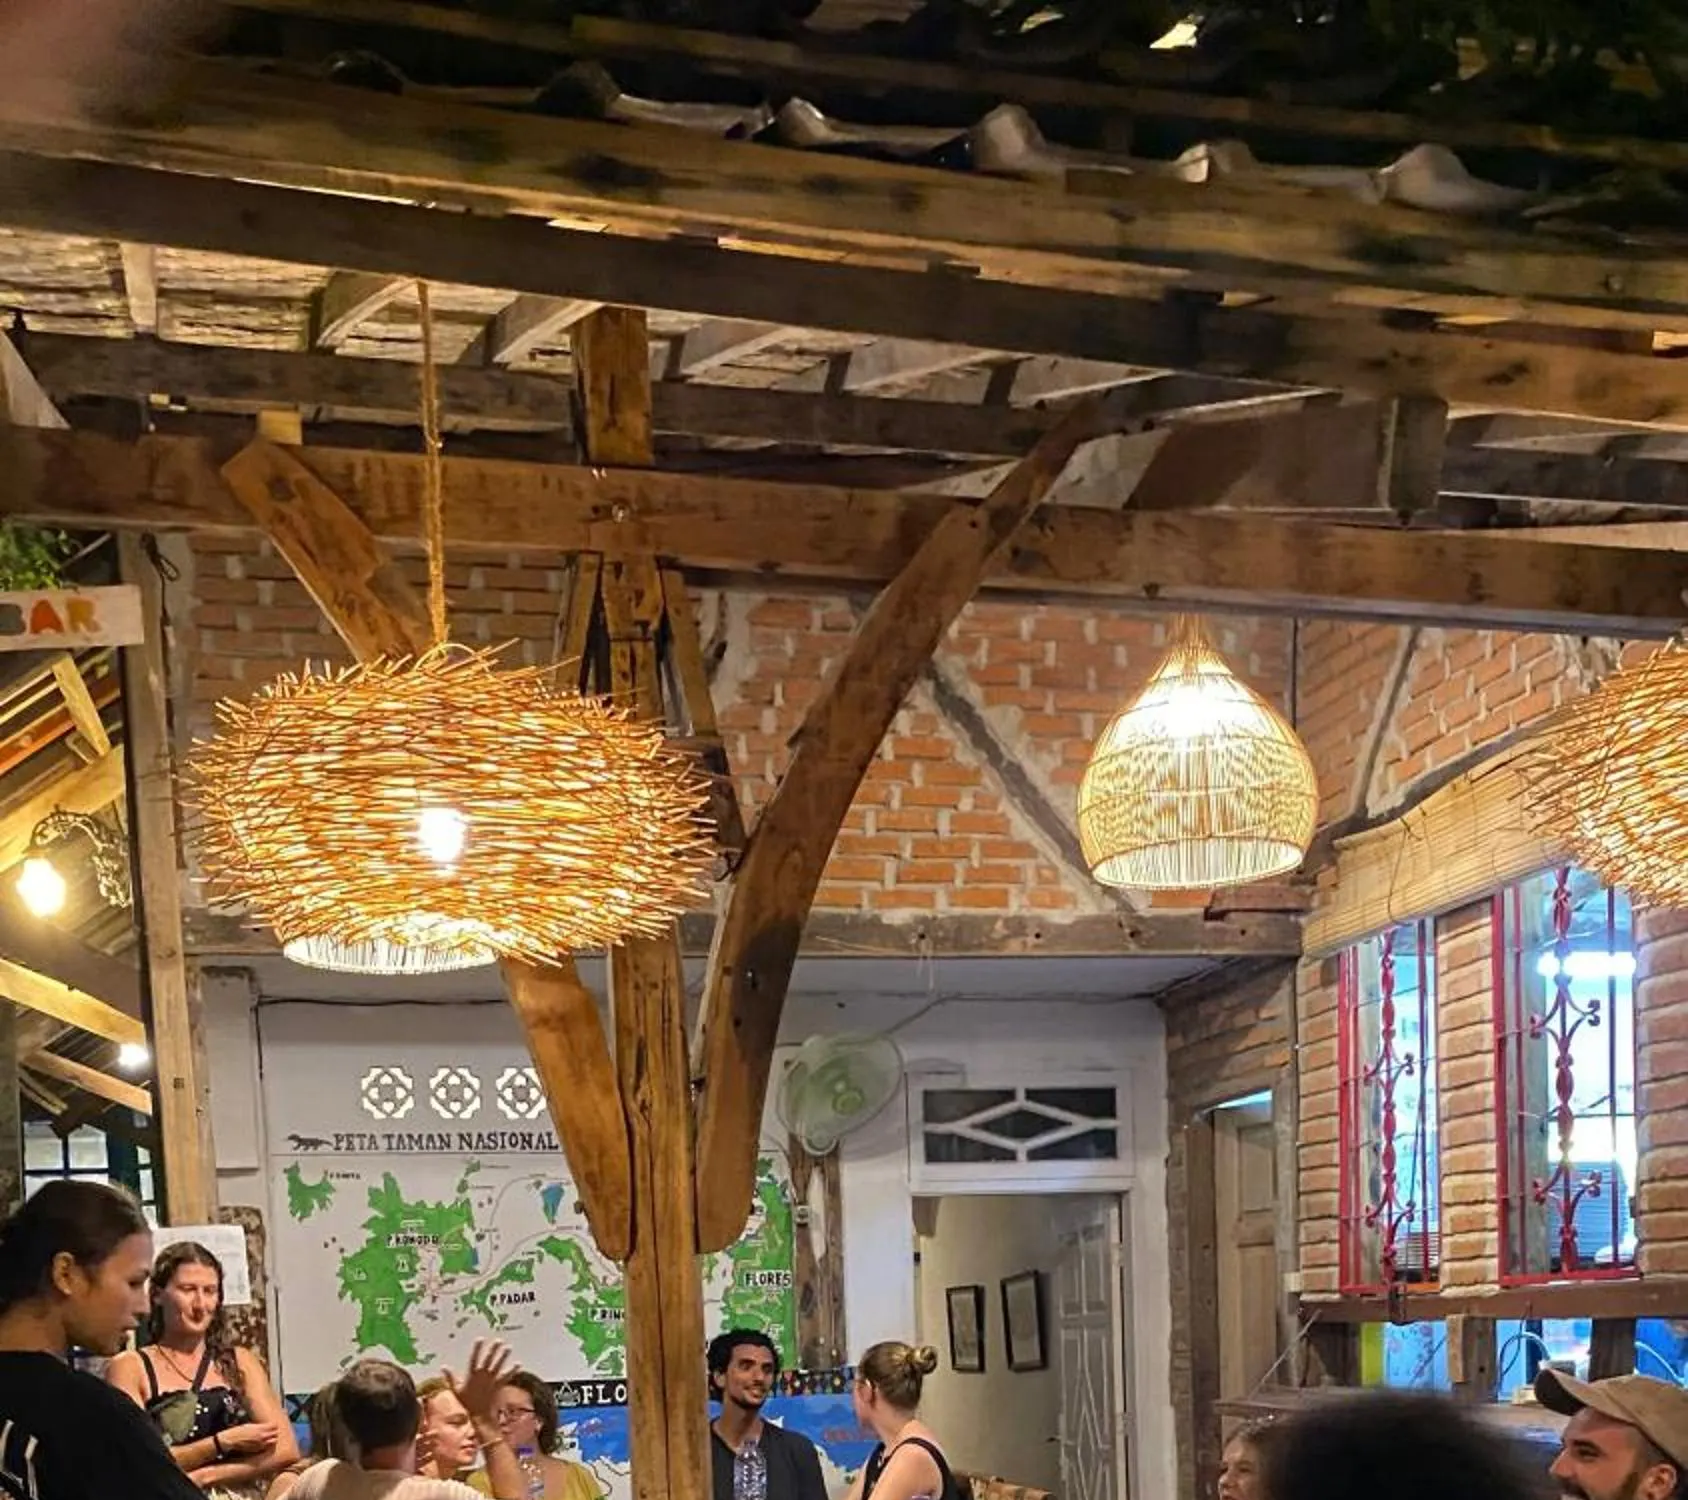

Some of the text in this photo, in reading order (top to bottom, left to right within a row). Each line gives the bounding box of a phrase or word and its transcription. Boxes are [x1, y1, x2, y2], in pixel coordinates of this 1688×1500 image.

[0, 599, 100, 636] BAR
[333, 1131, 559, 1151] PETA TAMAN NASIONAL
[745, 1273, 791, 1287] FLORES
